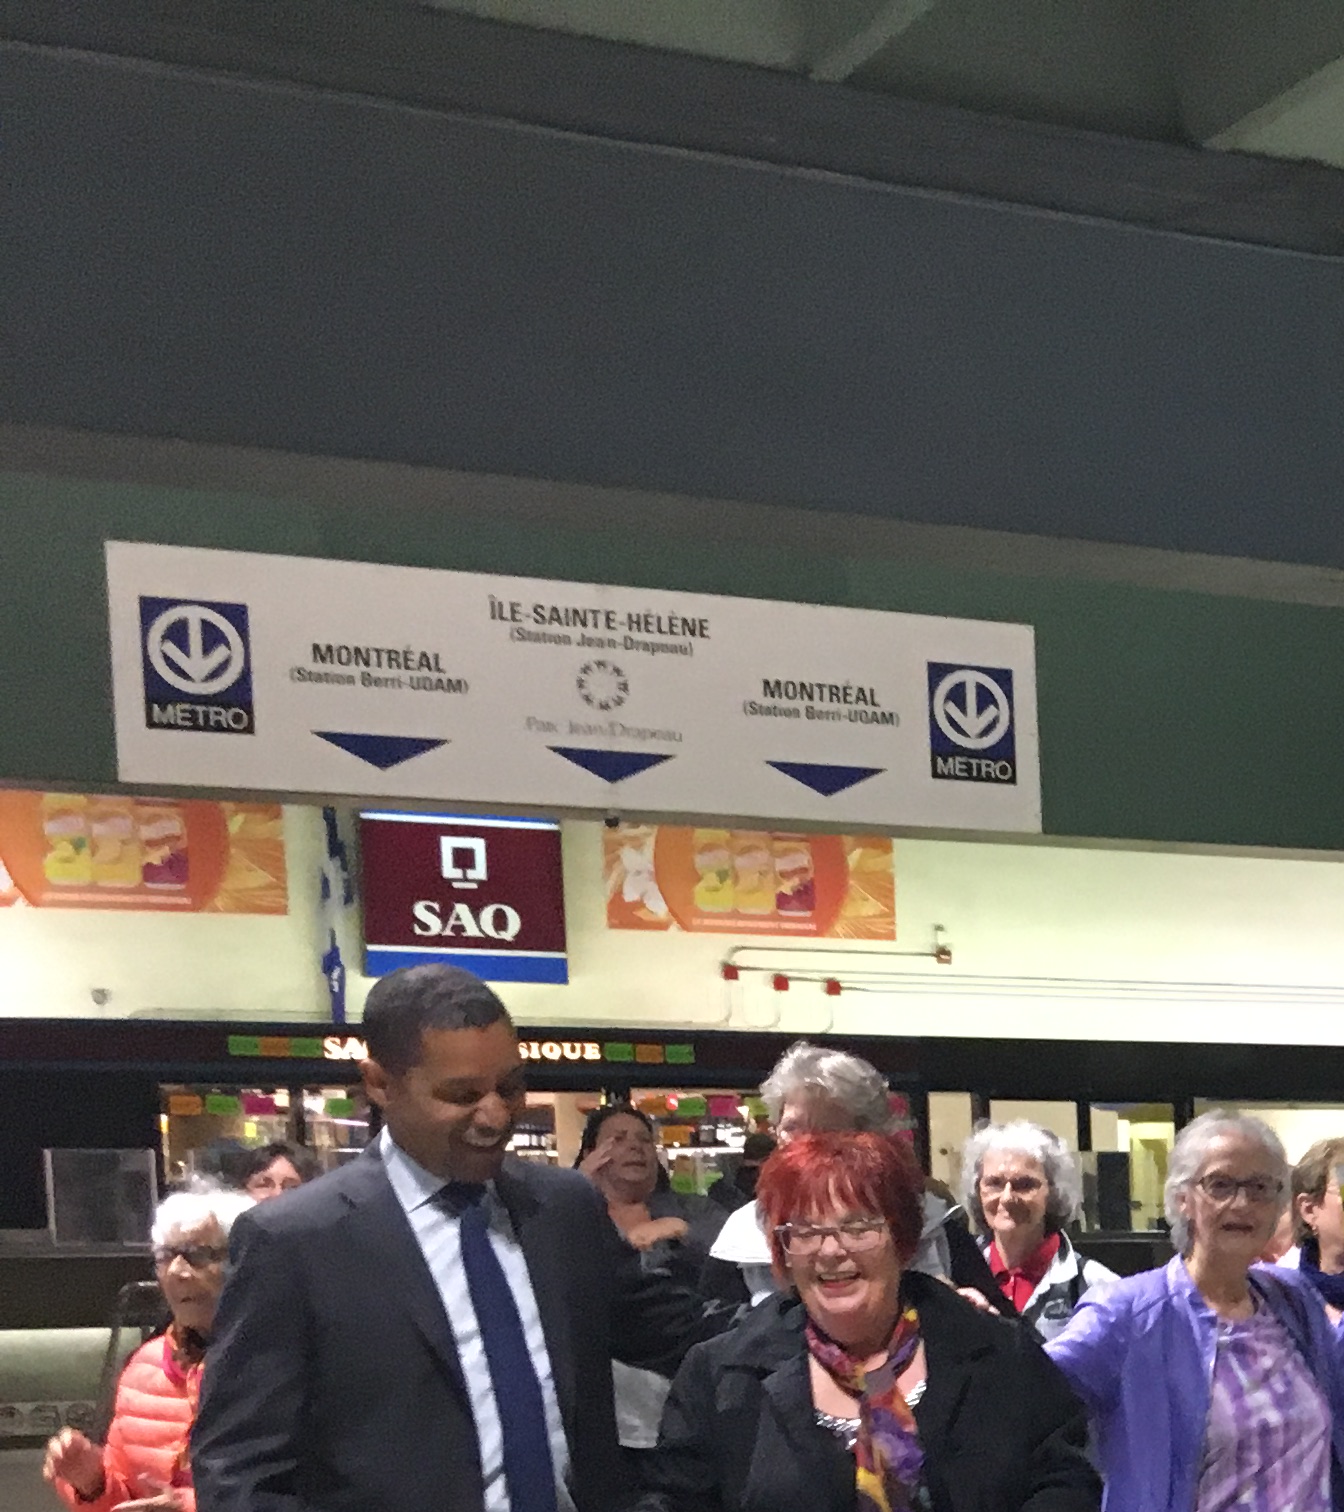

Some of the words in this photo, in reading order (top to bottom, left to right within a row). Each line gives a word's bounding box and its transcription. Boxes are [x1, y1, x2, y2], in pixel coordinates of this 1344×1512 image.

[311, 643, 447, 674] MONTRÉAL
[761, 678, 881, 708] MONTRÉAL
[412, 900, 521, 941] SAQ
[323, 1036, 370, 1060] SA
